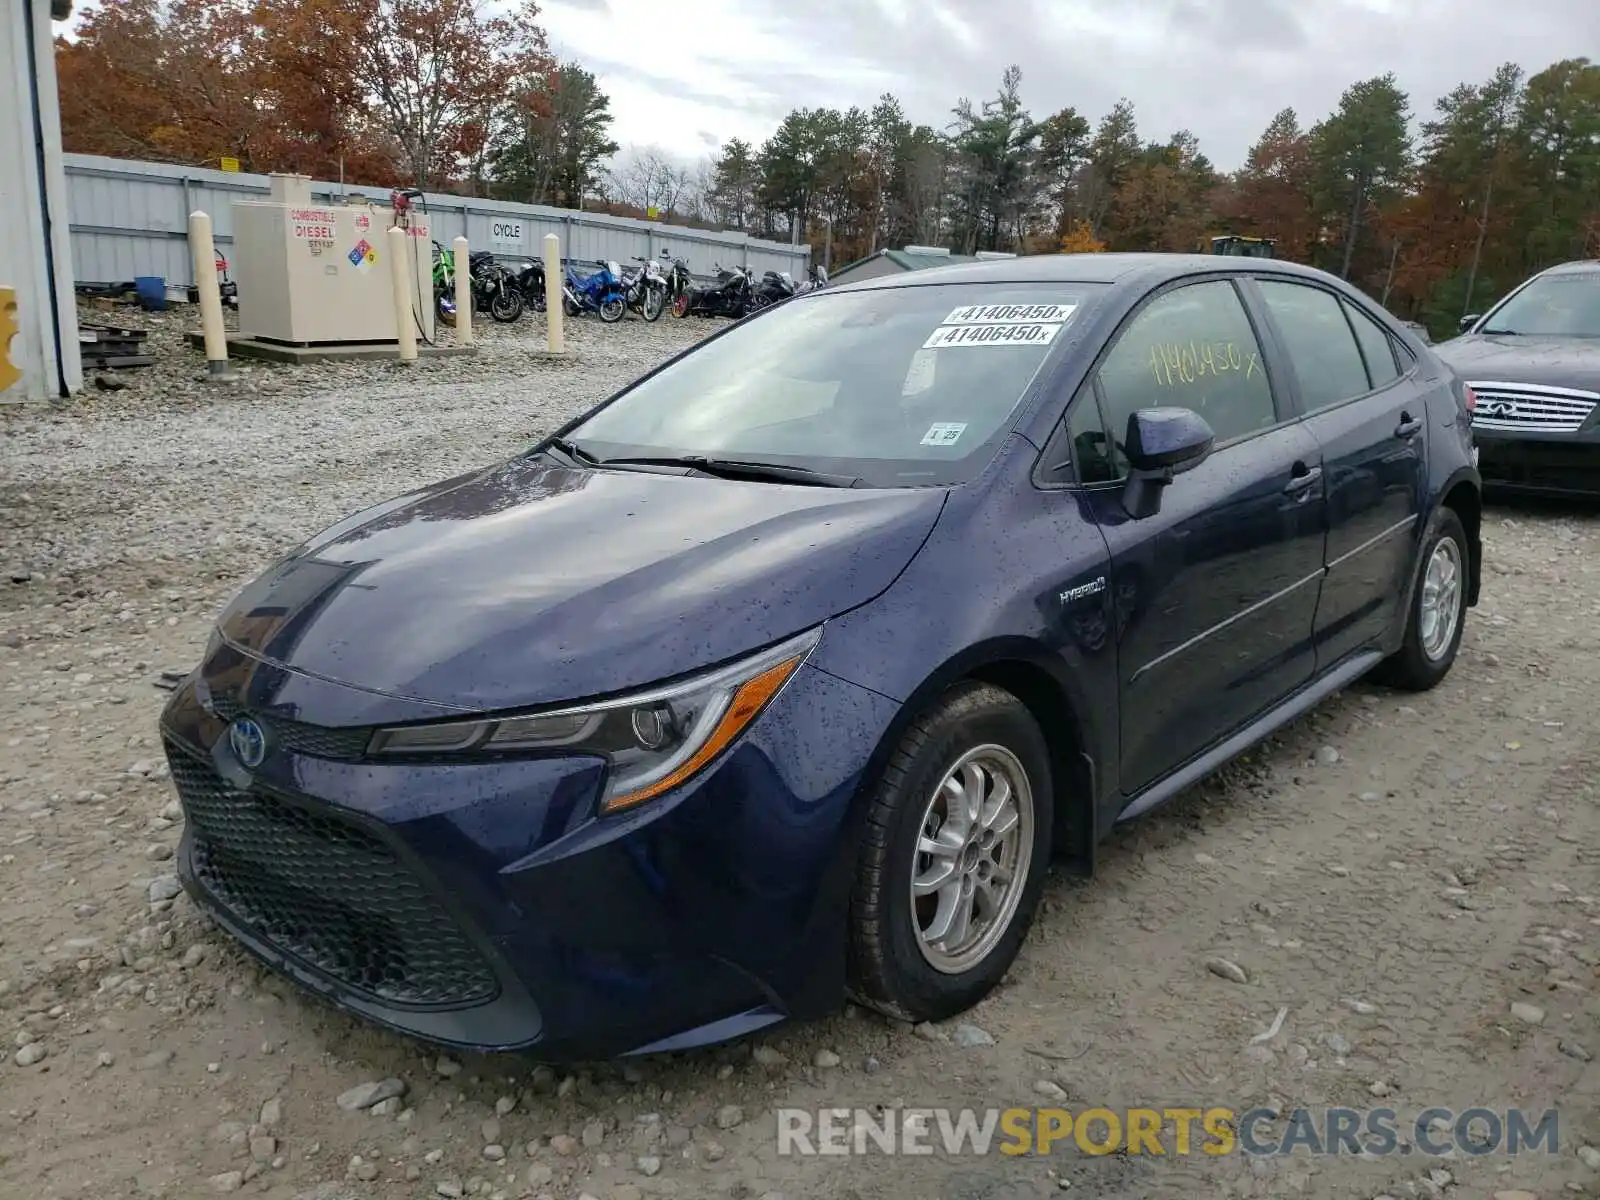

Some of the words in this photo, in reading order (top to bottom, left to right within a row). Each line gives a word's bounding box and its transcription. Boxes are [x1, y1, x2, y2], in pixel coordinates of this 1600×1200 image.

[295, 225, 333, 238] DIESEL
[493, 223, 520, 238] CYCLE
[943, 430, 961, 440] 25
[1059, 577, 1105, 604] HYBRID
